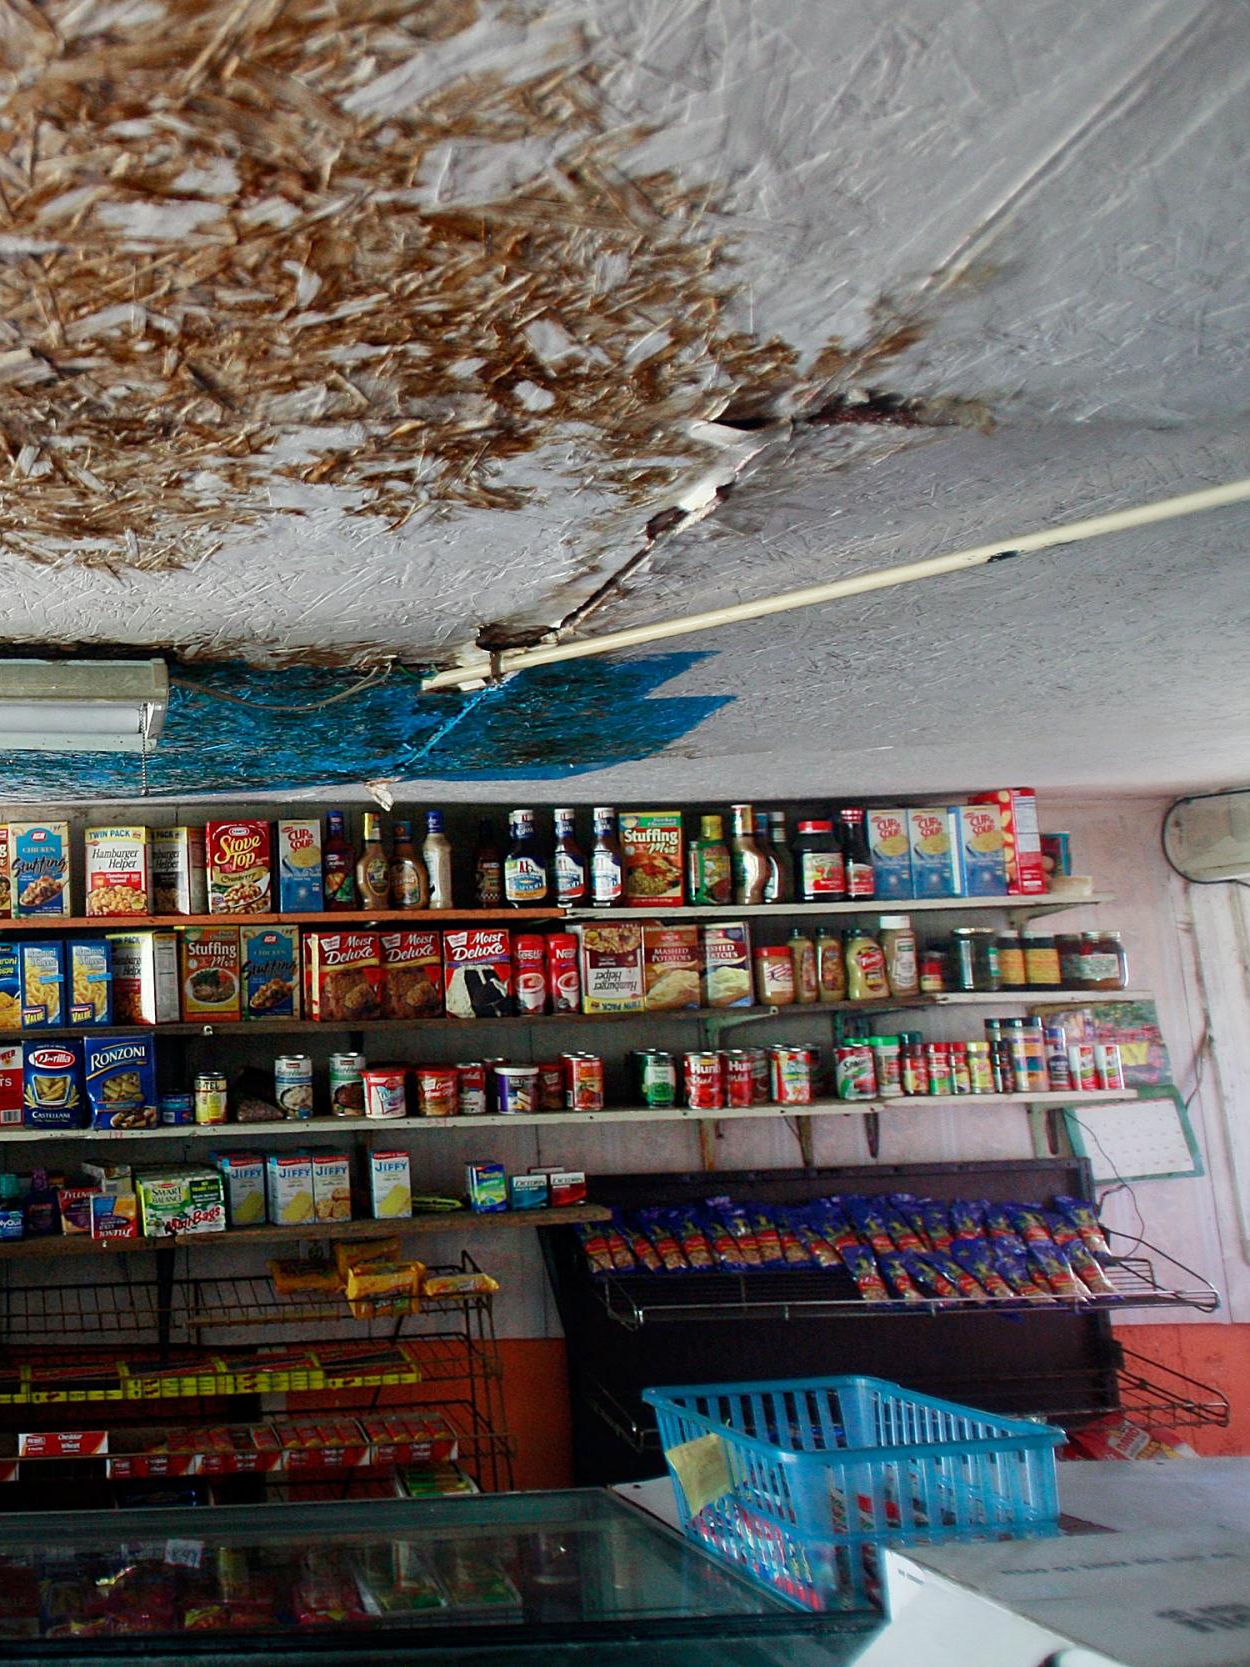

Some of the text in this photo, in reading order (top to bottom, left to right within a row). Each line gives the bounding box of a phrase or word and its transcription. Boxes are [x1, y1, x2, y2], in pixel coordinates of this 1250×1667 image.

[89, 829, 130, 839] TWIN PACK
[288, 829, 309, 841] CUP
[624, 828, 678, 845] Stuffing
[214, 835, 261, 864] Stove
[290, 839, 314, 853] SOUP
[646, 843, 677, 855] Mix
[92, 849, 139, 861] Hamburger
[230, 852, 255, 870] Top
[12, 856, 67, 878] Stuffing
[108, 858, 137, 870] Helper
[343, 935, 375, 948] Moist
[405, 933, 434, 947] Moist
[474, 932, 503, 945] Moist
[188, 942, 236, 958] Stuffing
[387, 944, 438, 961] Deluxe
[453, 941, 506, 961] Deluxe
[654, 948, 689, 956] MASHED
[709, 944, 735, 952] SHED
[325, 945, 375, 964] Deluxe
[652, 955, 691, 963] POTATOES
[210, 956, 235, 967] Mix
[595, 969, 623, 981] Helper
[593, 981, 637, 993] Hamburger
[91, 1046, 145, 1071] RONZONI
[231, 1168, 262, 1179] JIFFY
[279, 1168, 311, 1179] JIFFY
[316, 1166, 348, 1177] JIFFY
[375, 1162, 407, 1173] JIFFY
[151, 1187, 182, 1196] SMART
[192, 1207, 221, 1225] Bags
[1117, 1425, 1140, 1450] DAVID
